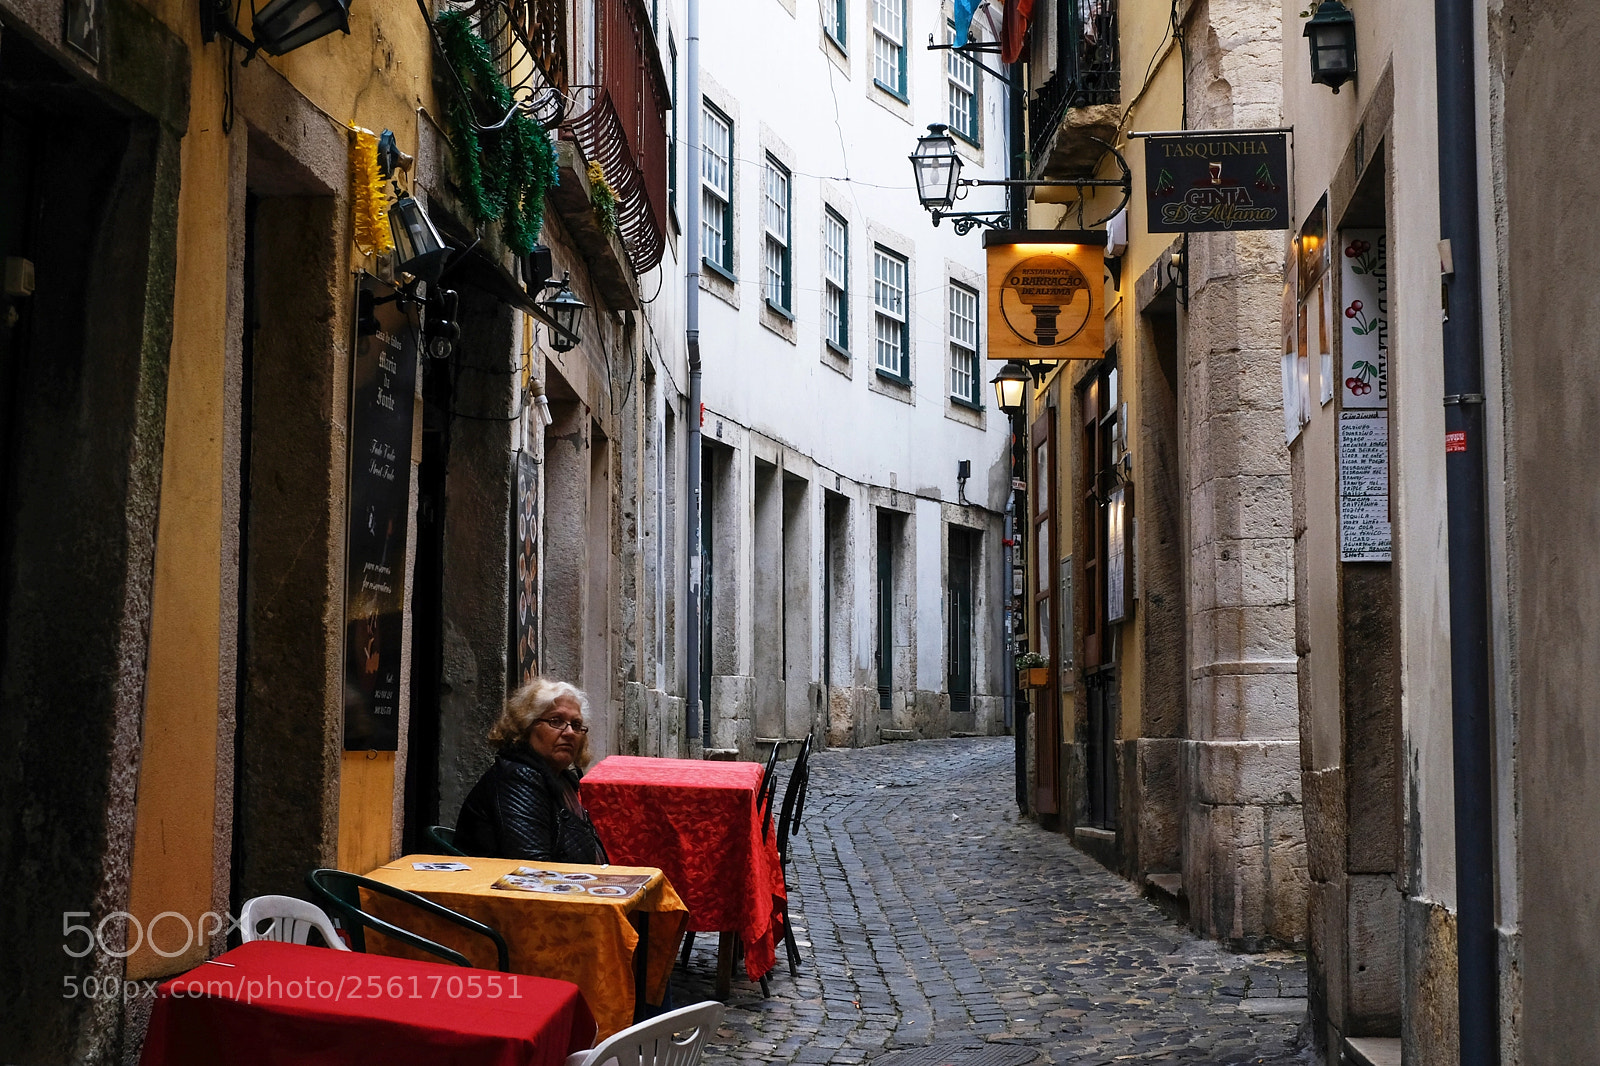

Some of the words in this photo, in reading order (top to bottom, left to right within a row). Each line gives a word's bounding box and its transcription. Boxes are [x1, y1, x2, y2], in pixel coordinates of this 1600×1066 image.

[1161, 141, 1269, 159] TASQUINHA
[1010, 277, 1020, 286] O
[1021, 276, 1082, 286] BARRACÃO
[379, 351, 397, 375] Maria
